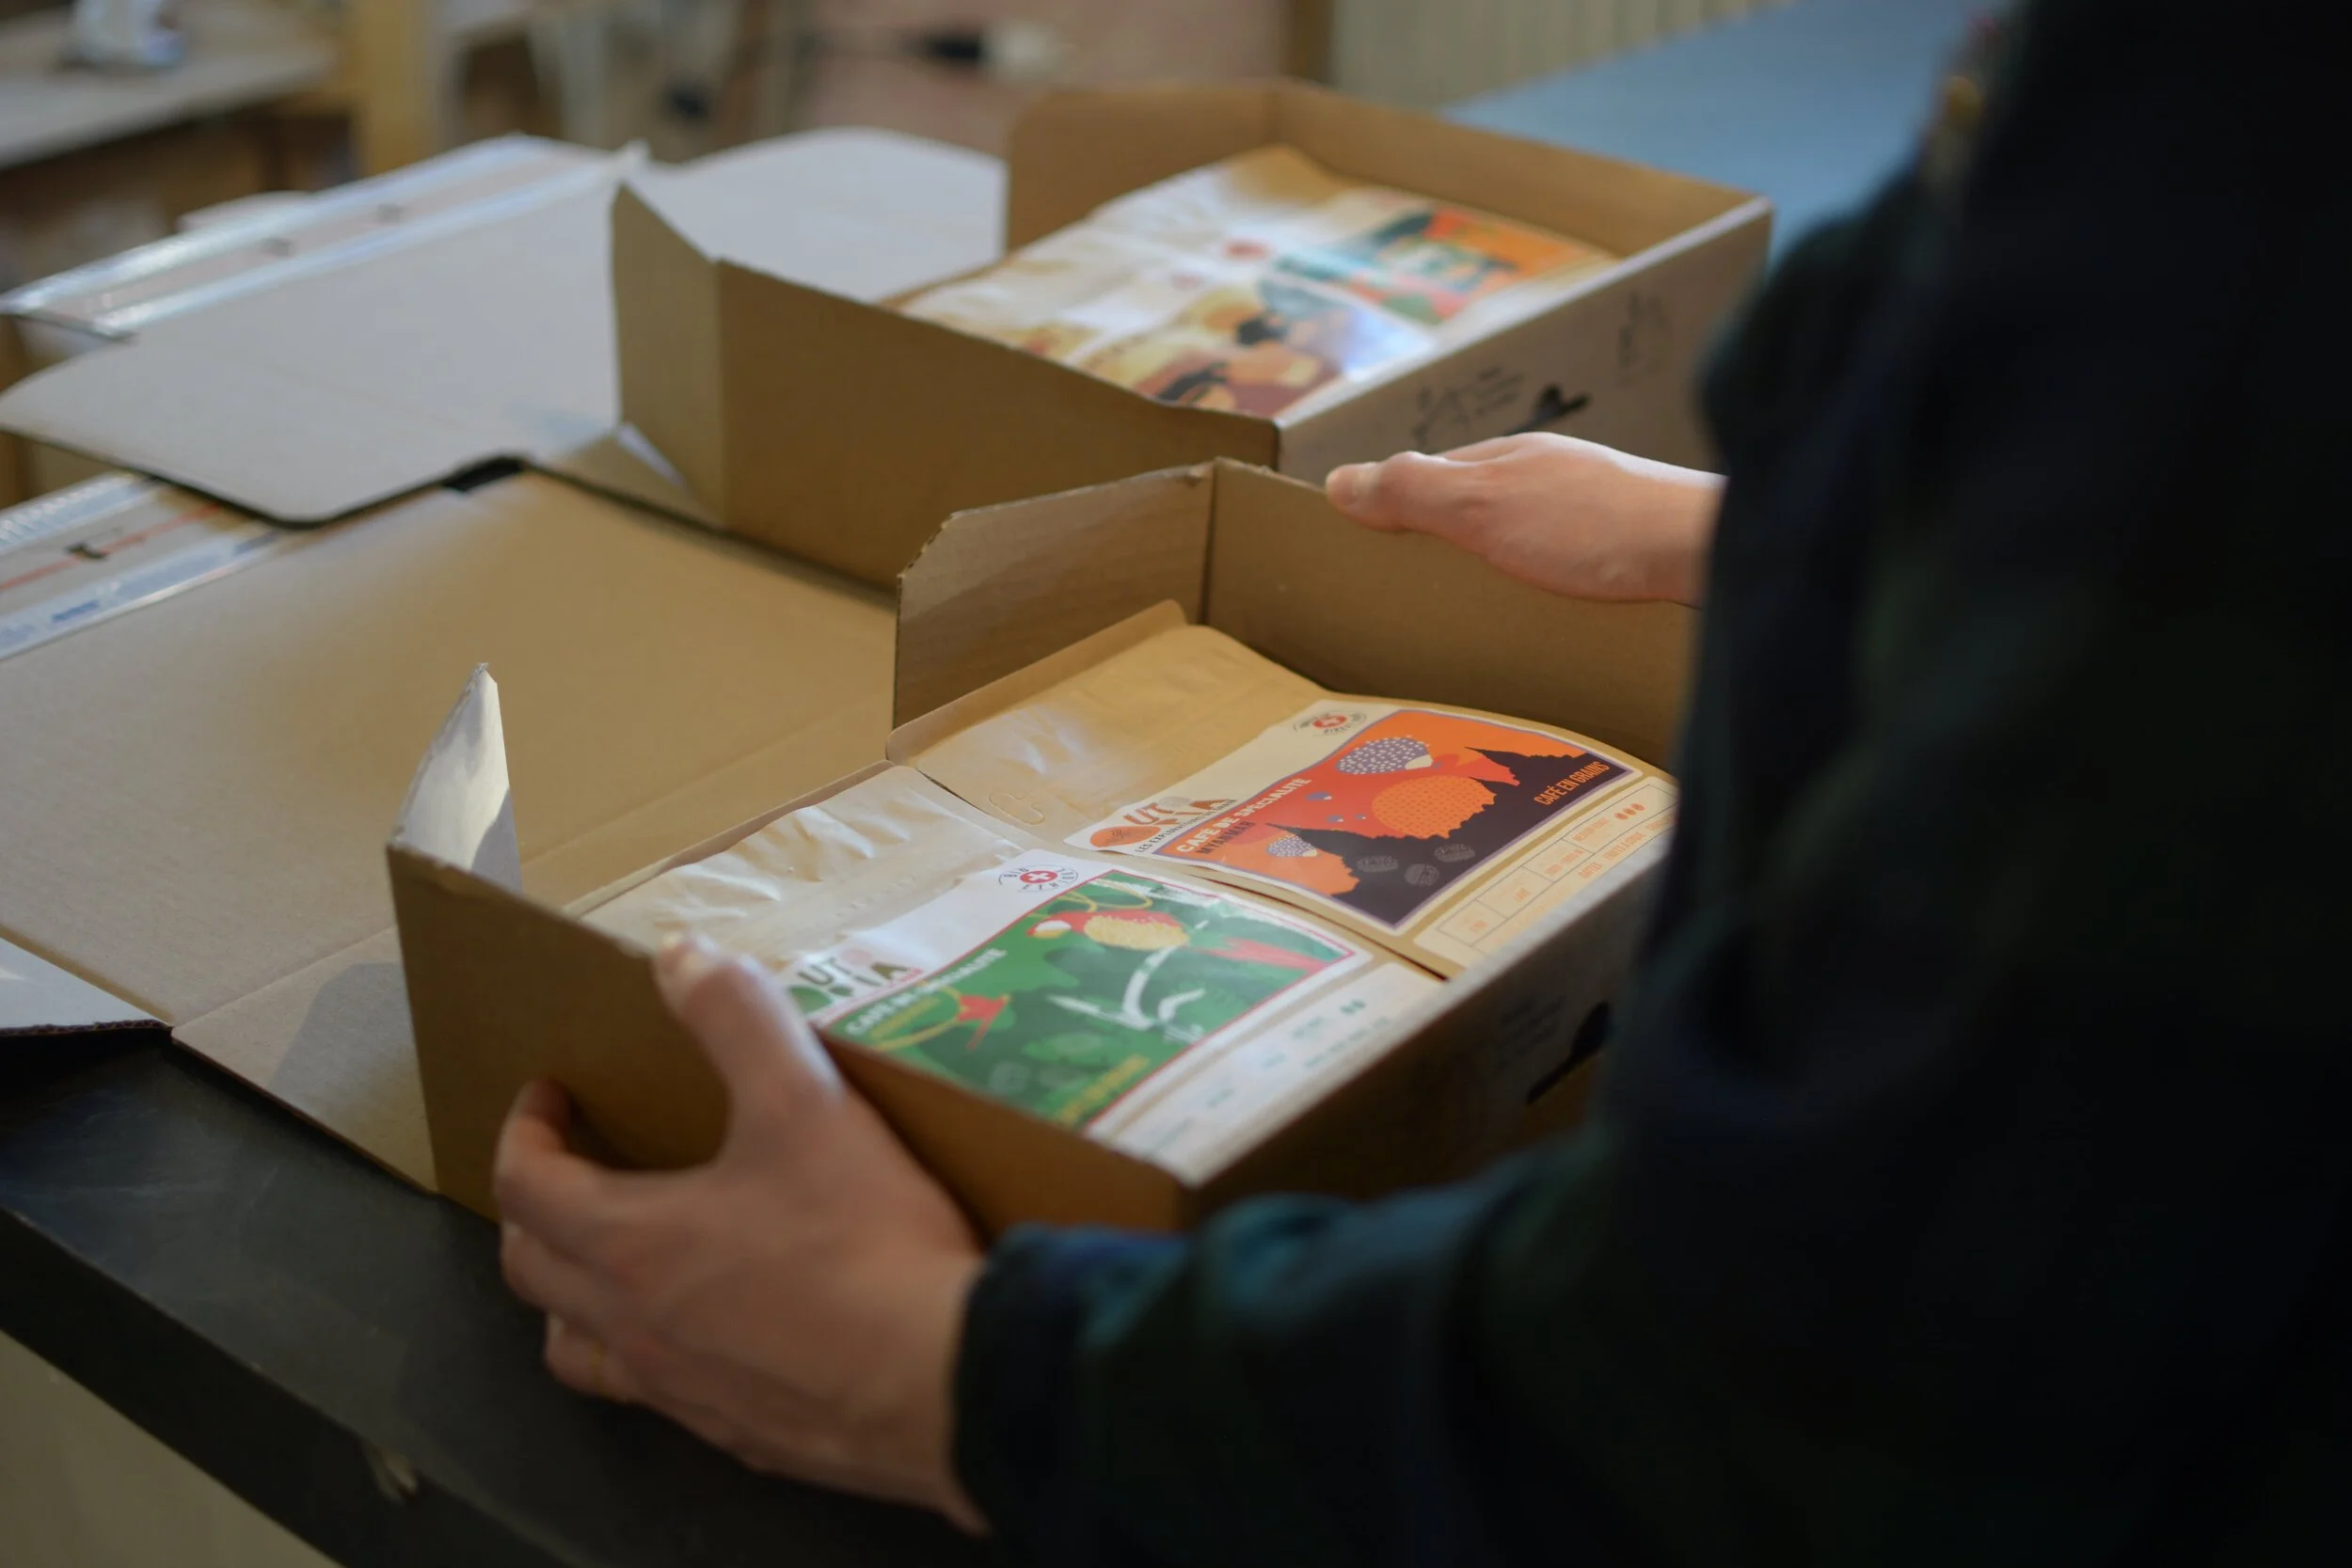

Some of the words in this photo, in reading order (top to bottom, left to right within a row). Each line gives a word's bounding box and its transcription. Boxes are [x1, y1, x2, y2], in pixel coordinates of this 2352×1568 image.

[1568, 761, 1611, 784] GRAINS
[1556, 778, 1581, 791] EN
[1534, 785, 1567, 805] CAFÉ
[1176, 826, 1222, 852] CAFÉ
[1212, 816, 1241, 829] DE
[1135, 841, 1152, 853] LES
